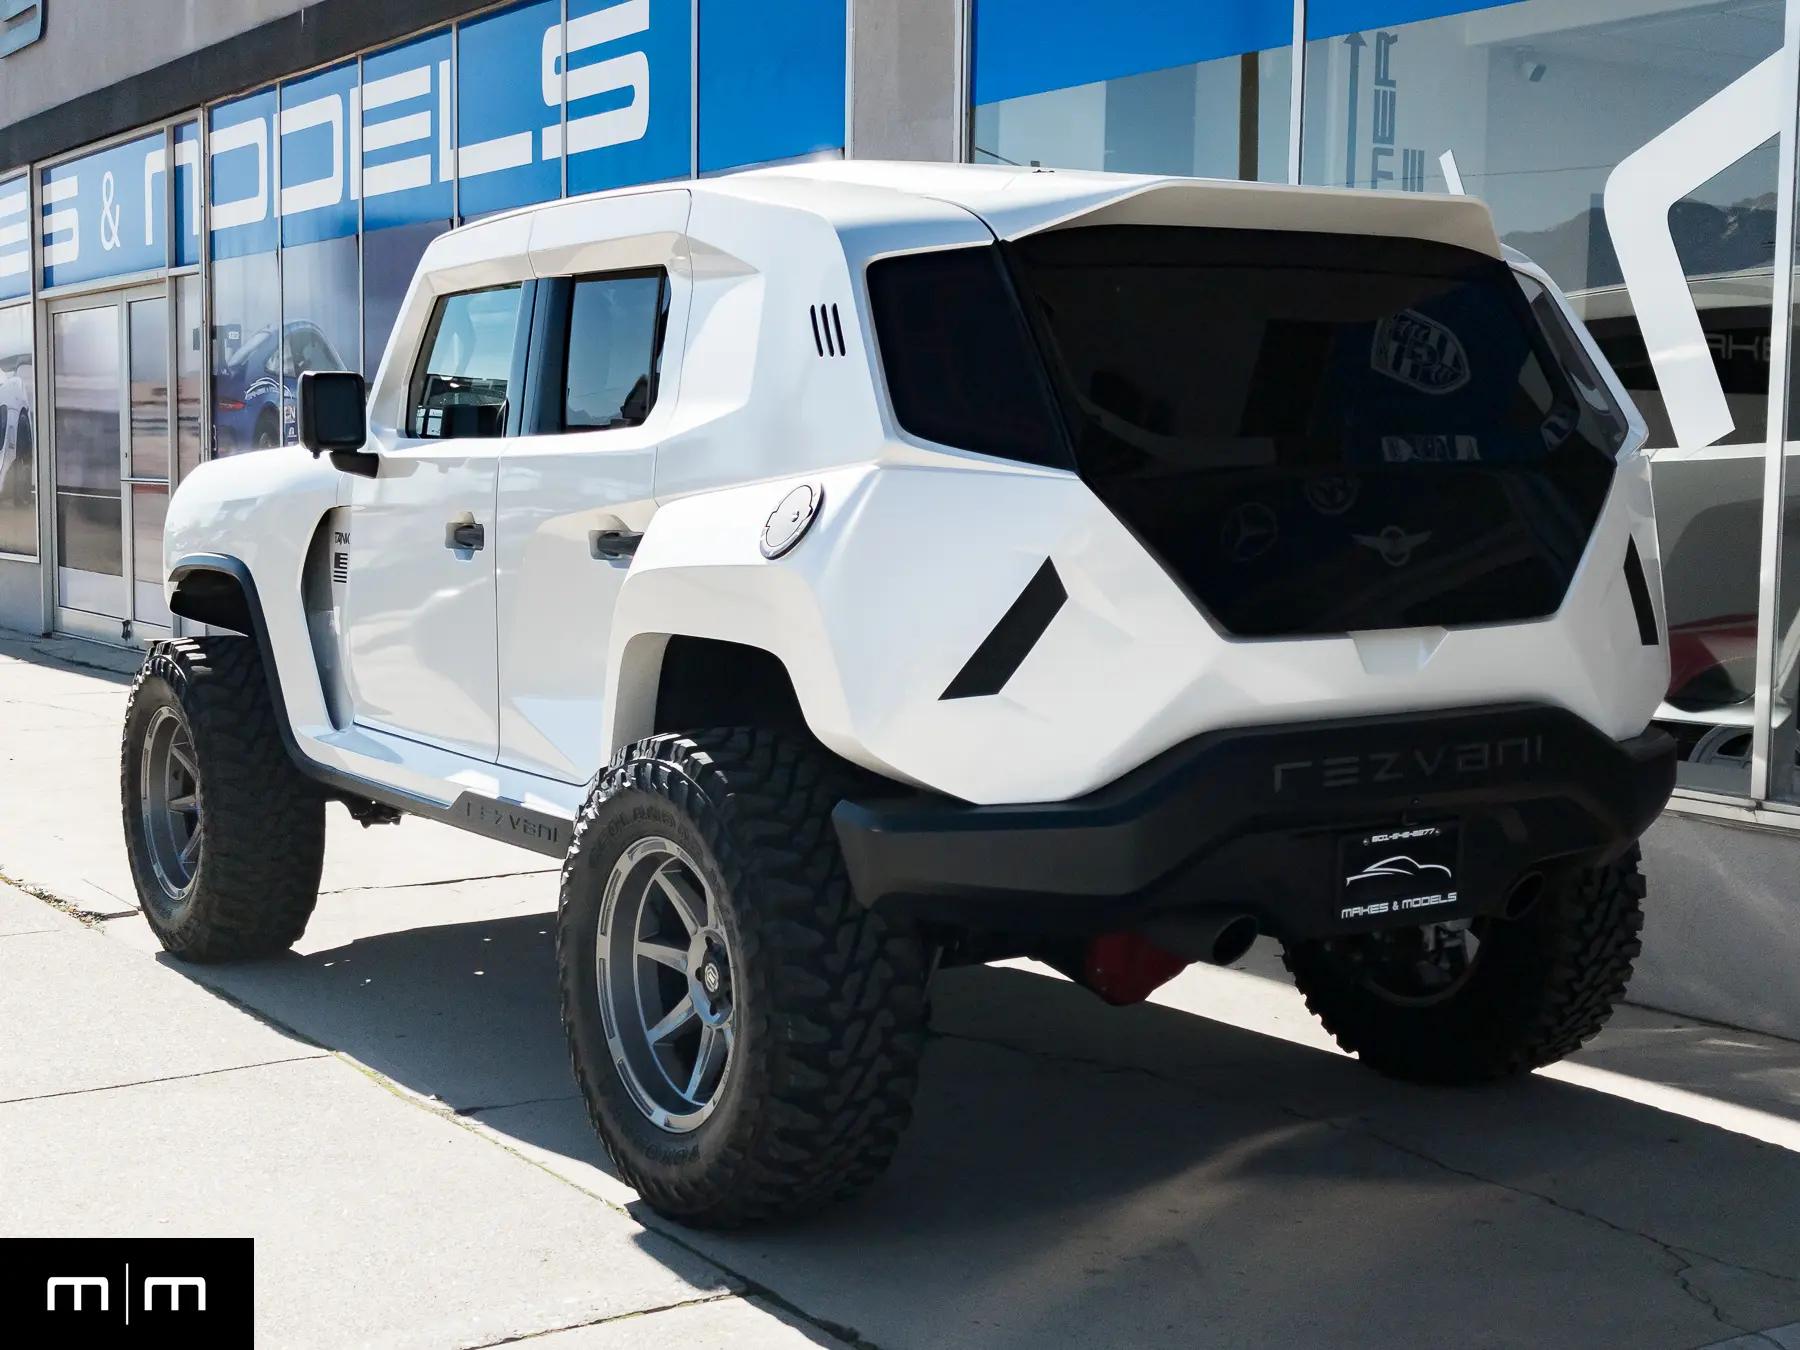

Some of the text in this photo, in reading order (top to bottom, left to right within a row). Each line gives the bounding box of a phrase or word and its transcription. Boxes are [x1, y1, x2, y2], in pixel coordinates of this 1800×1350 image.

[101, 170, 121, 251] &
[144, 0, 649, 246] MODELS
[1341, 891, 1458, 919] MAKES & MODELS
